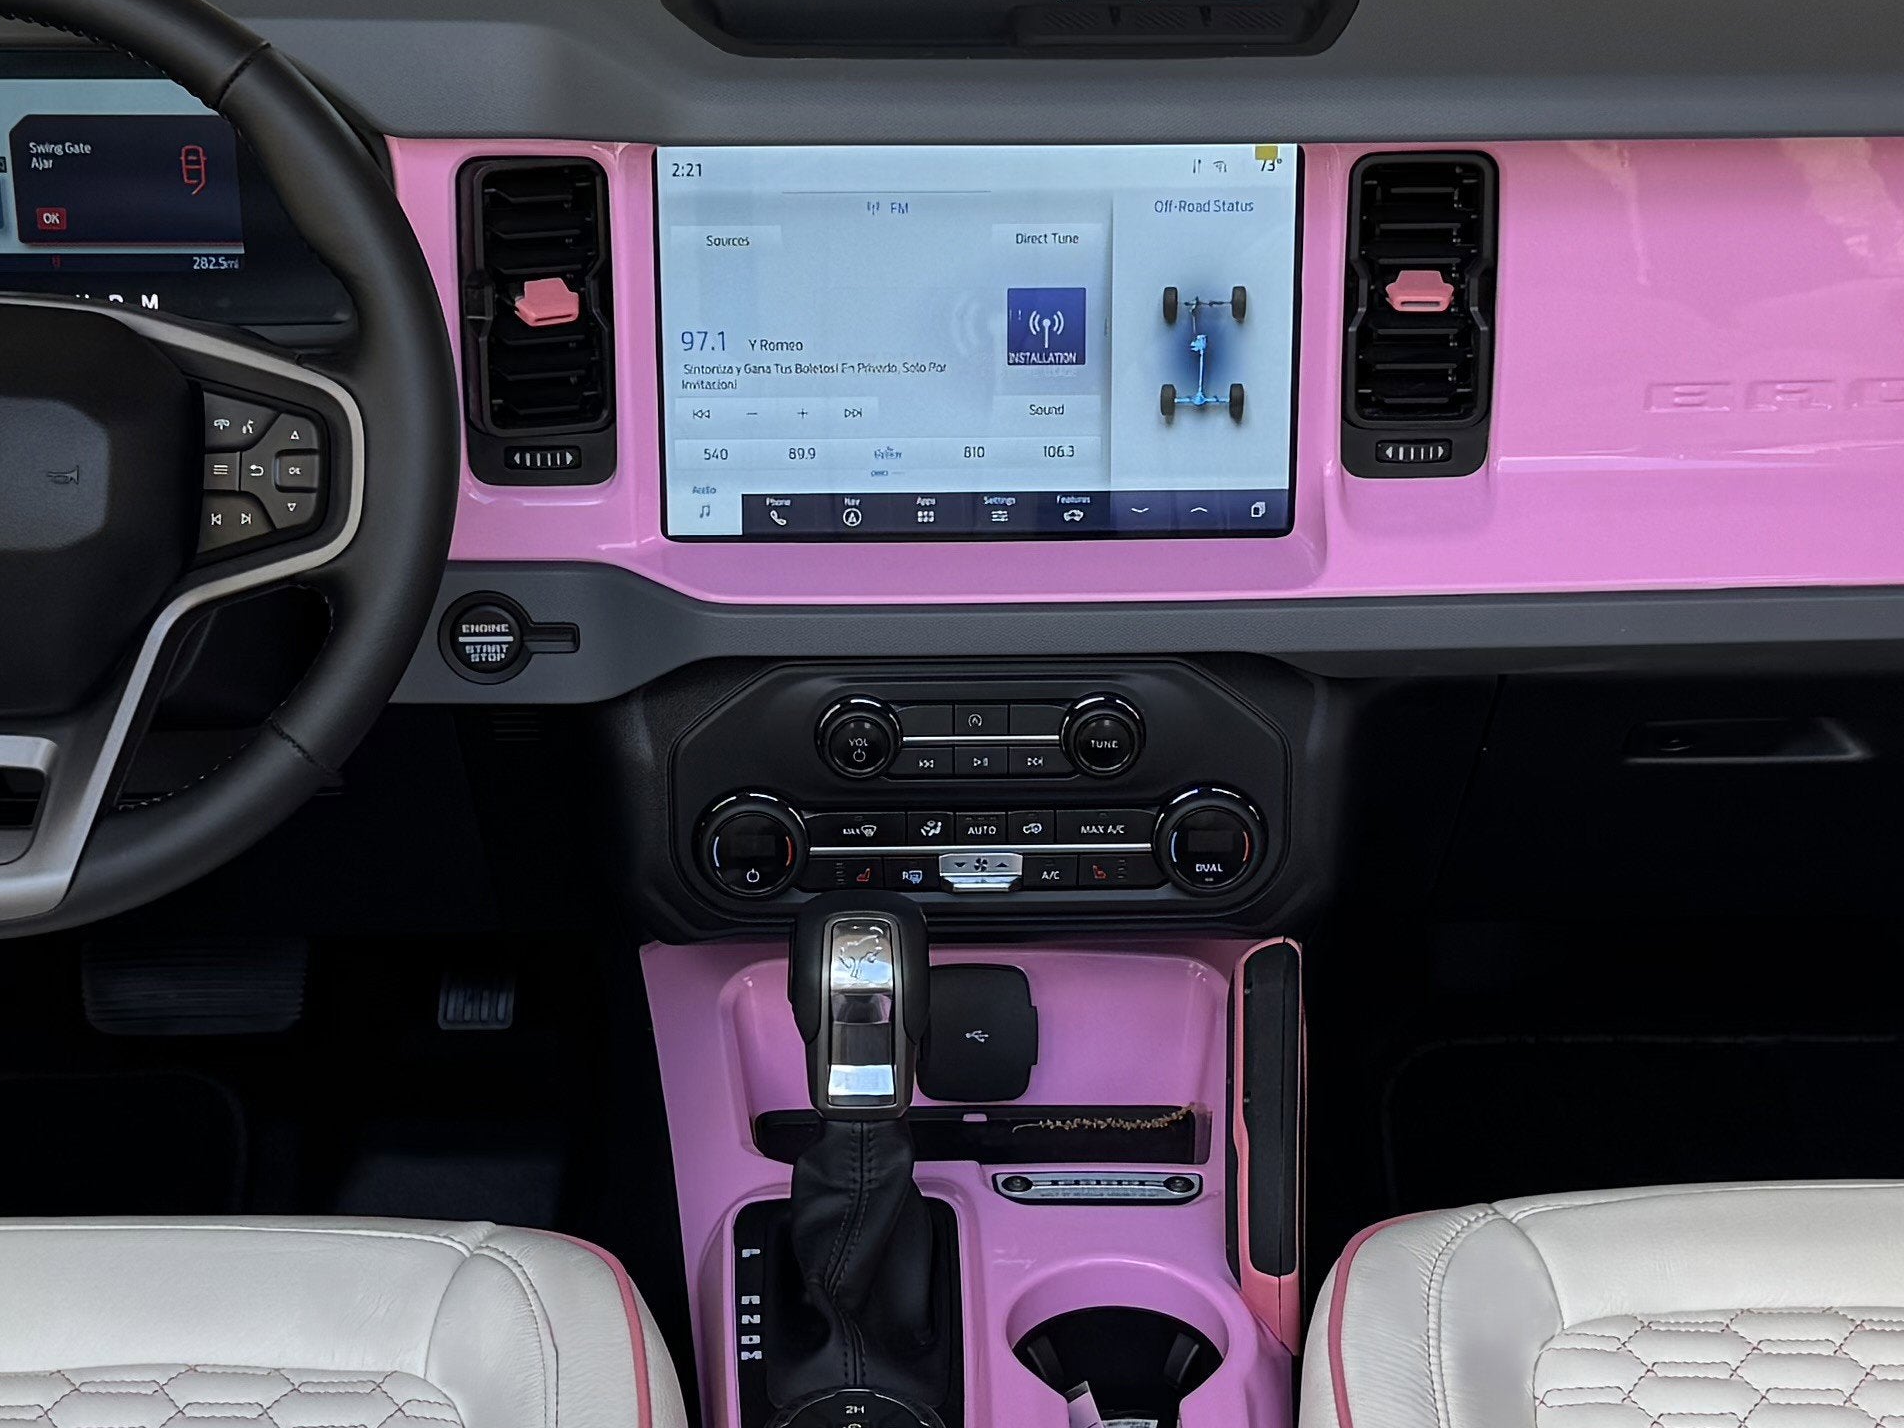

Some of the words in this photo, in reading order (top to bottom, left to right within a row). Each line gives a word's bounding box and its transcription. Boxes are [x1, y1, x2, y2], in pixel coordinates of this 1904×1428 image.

[29, 142, 64, 155] Swing
[65, 142, 91, 154] Gate
[31, 158, 53, 170] Ajar
[672, 163, 702, 177] 2:21
[890, 202, 909, 215] FM
[1154, 200, 1210, 213] Off-Road
[1214, 200, 1254, 213] Status
[43, 213, 60, 224] OK
[706, 235, 750, 247] Sources
[1015, 232, 1048, 245] Direct
[1052, 232, 1079, 245] Tune
[141, 294, 158, 310] M
[681, 331, 726, 352] 97.1
[748, 339, 757, 351] Y
[760, 339, 803, 351] Romeo
[1009, 352, 1076, 364] INSTALLATION
[744, 364, 771, 374] Gana
[774, 364, 792, 374] Tus
[1029, 404, 1064, 415] Sound
[704, 448, 728, 460] 540
[789, 447, 816, 460] 89.9
[964, 446, 985, 458] 810
[1043, 445, 1075, 458] 106.3
[462, 624, 509, 633] ENGINE
[466, 644, 508, 654] START
[471, 653, 505, 662] STOP
[849, 738, 868, 747] VOL
[1091, 739, 1118, 749] TUNE
[968, 826, 996, 835] AUTO
[1080, 825, 1104, 834] MAX
[1107, 825, 1124, 834] A/C
[1196, 864, 1223, 872] DUAL
[1041, 871, 1059, 880] A/C
[741, 1314, 760, 1324] N
[741, 1350, 762, 1361] M
[846, 1405, 864, 1414] 2H
